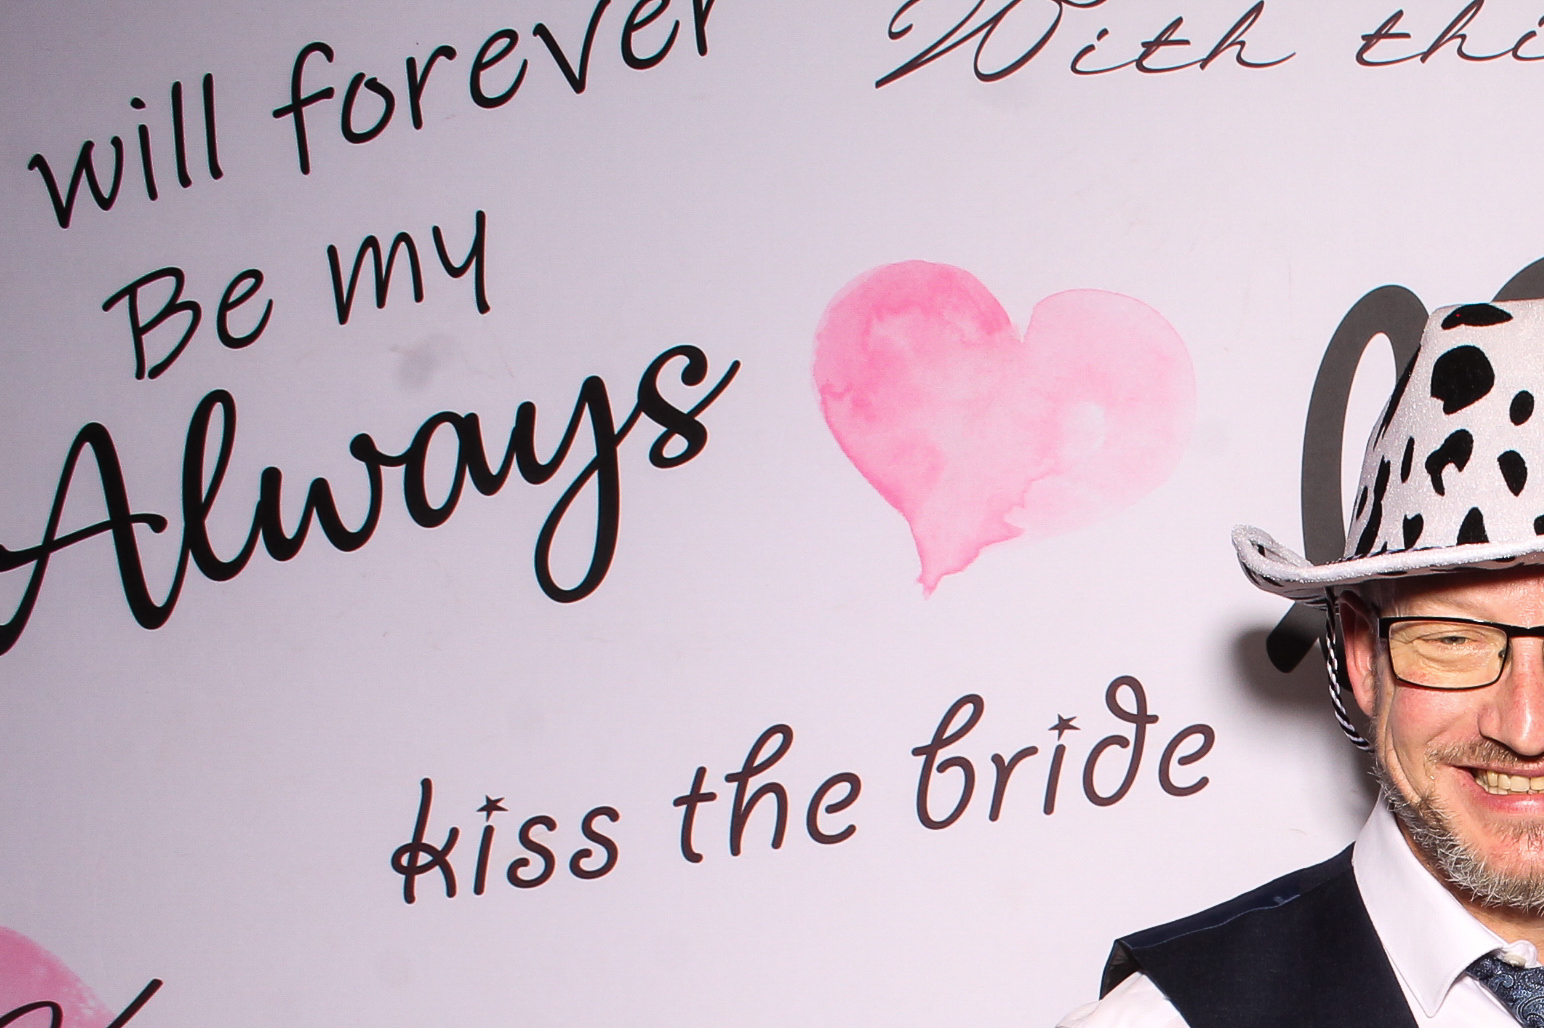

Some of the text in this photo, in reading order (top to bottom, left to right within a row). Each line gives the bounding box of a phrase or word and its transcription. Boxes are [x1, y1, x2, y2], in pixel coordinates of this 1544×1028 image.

[875, 0, 1295, 88] With
[27, 73, 223, 229] will
[102, 210, 490, 380] Be my
[0, 344, 740, 656] Always
[391, 676, 1214, 904] kiss the bride
